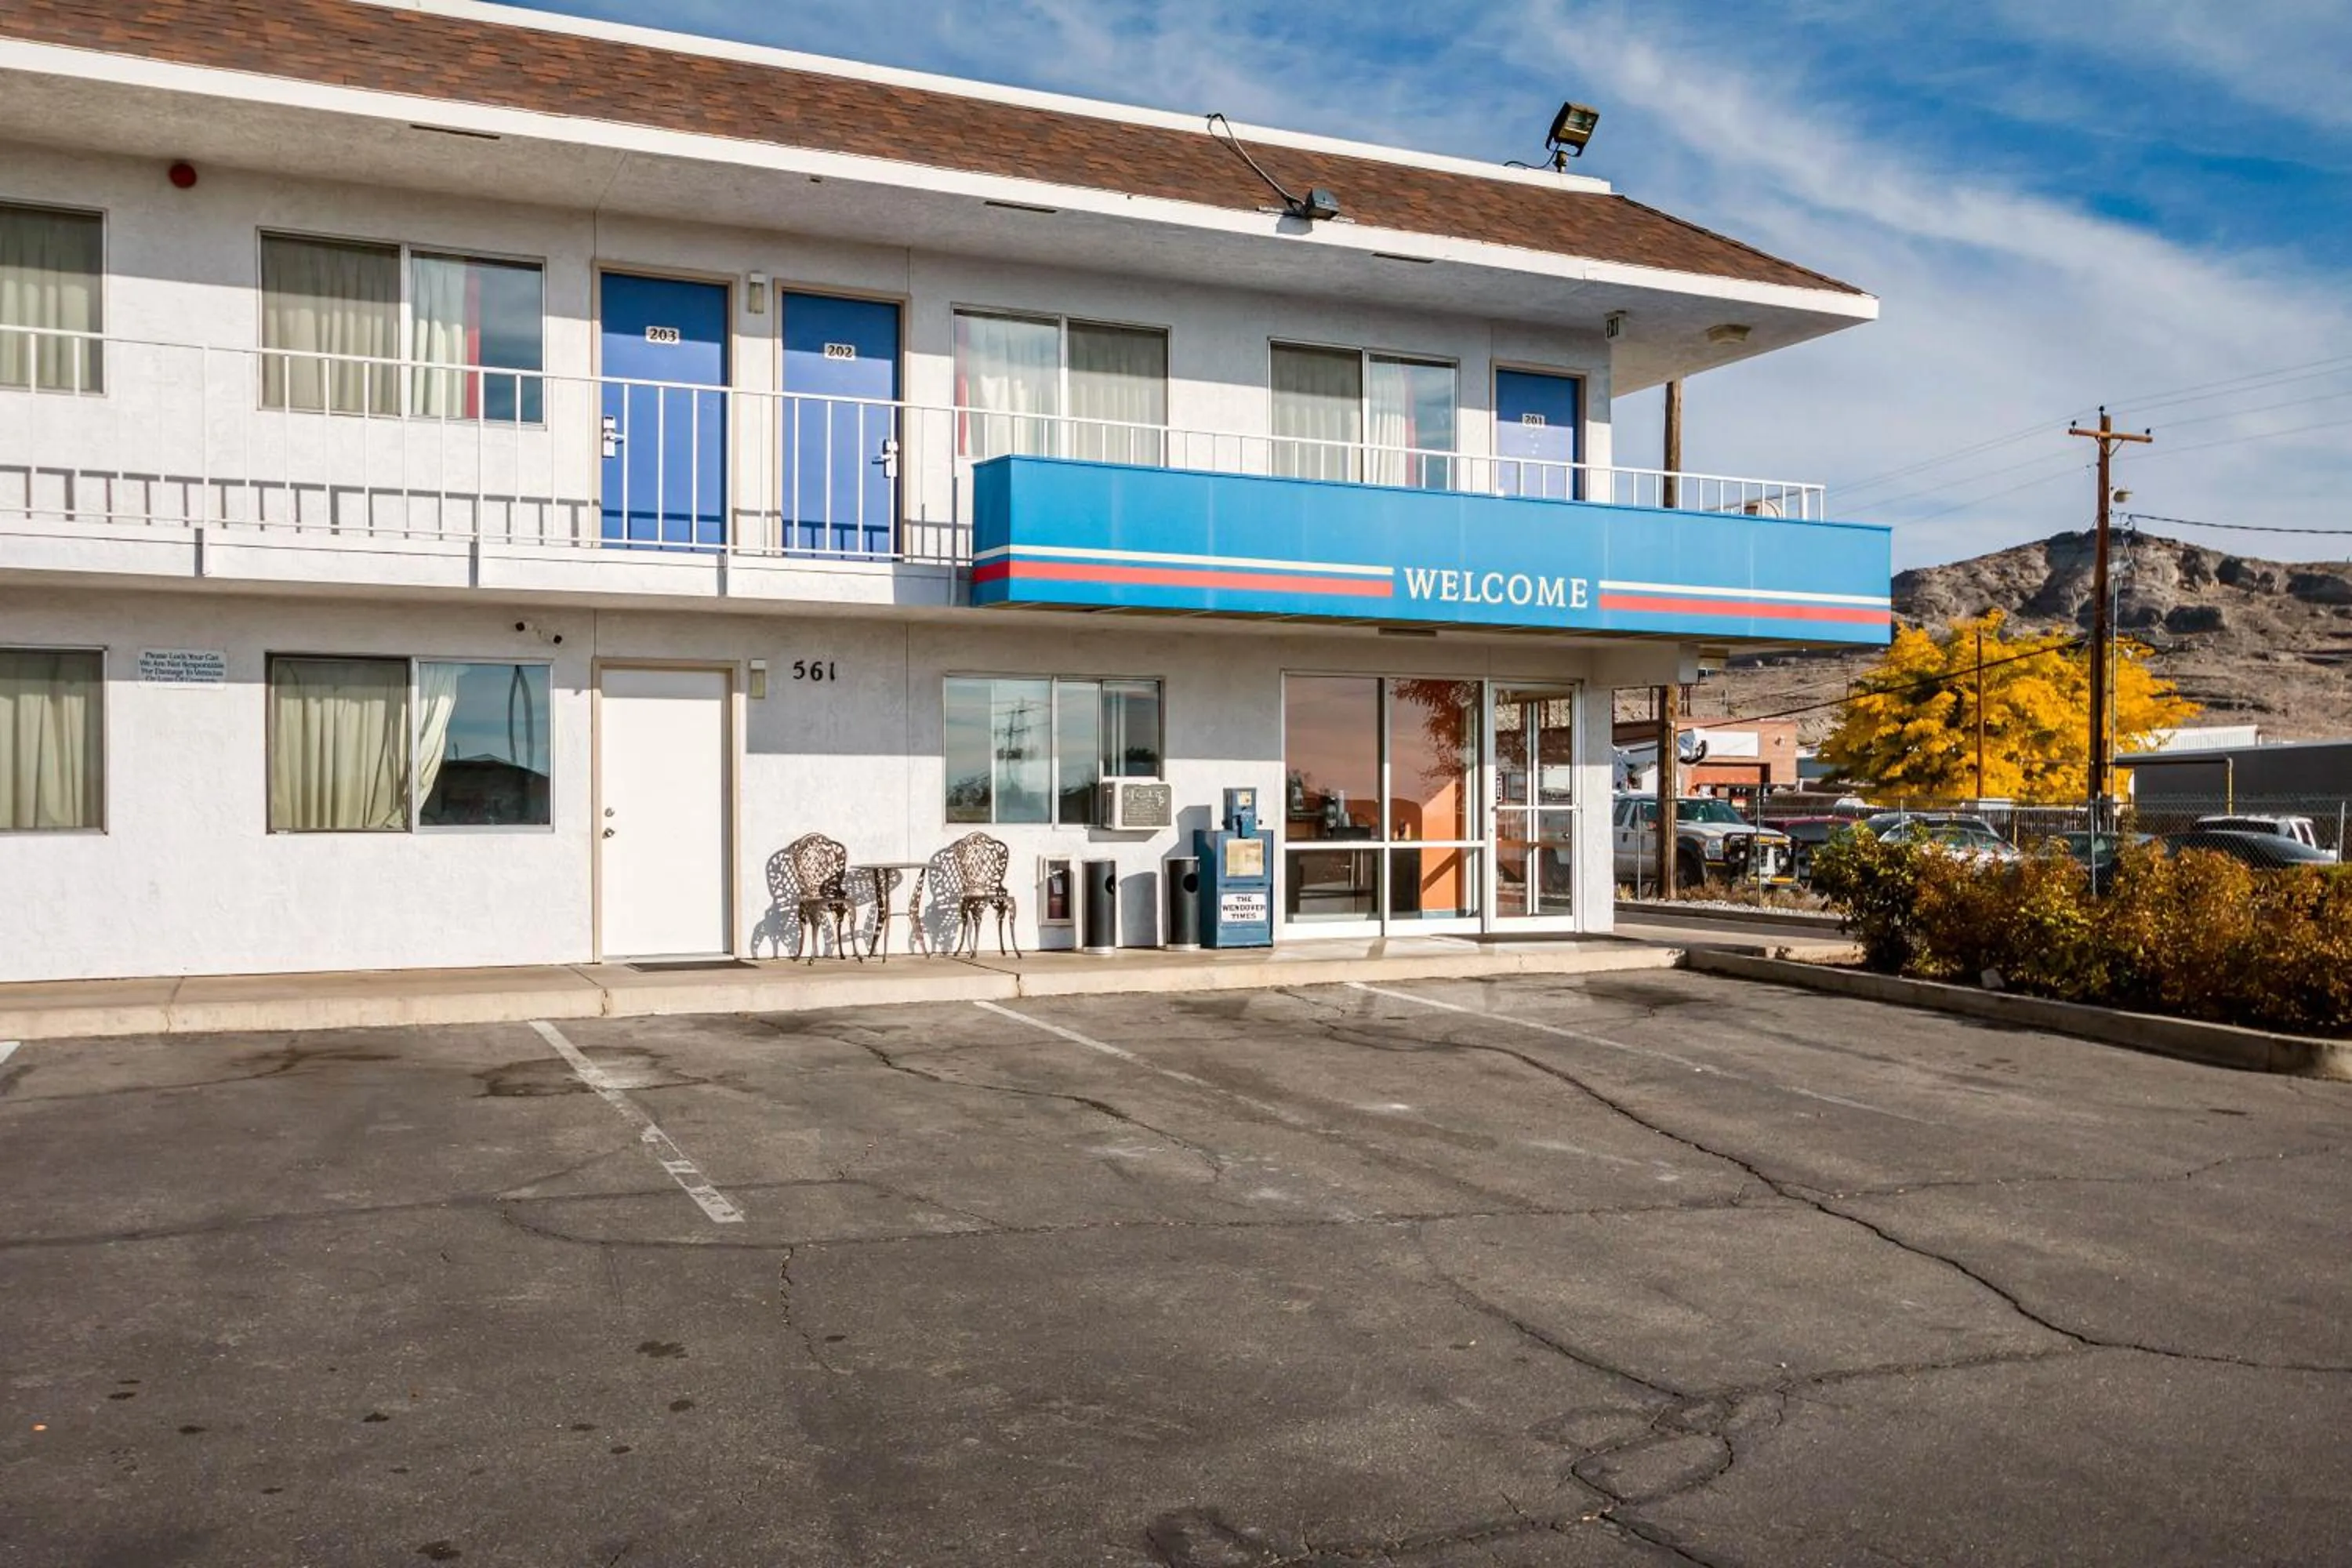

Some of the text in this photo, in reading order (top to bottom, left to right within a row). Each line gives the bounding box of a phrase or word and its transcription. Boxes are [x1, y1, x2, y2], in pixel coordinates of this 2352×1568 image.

[649, 328, 677, 342] 203
[827, 345, 852, 358] 202
[1524, 415, 1542, 426] 201
[1403, 566, 1588, 608] WELCOME
[793, 660, 835, 681] 561
